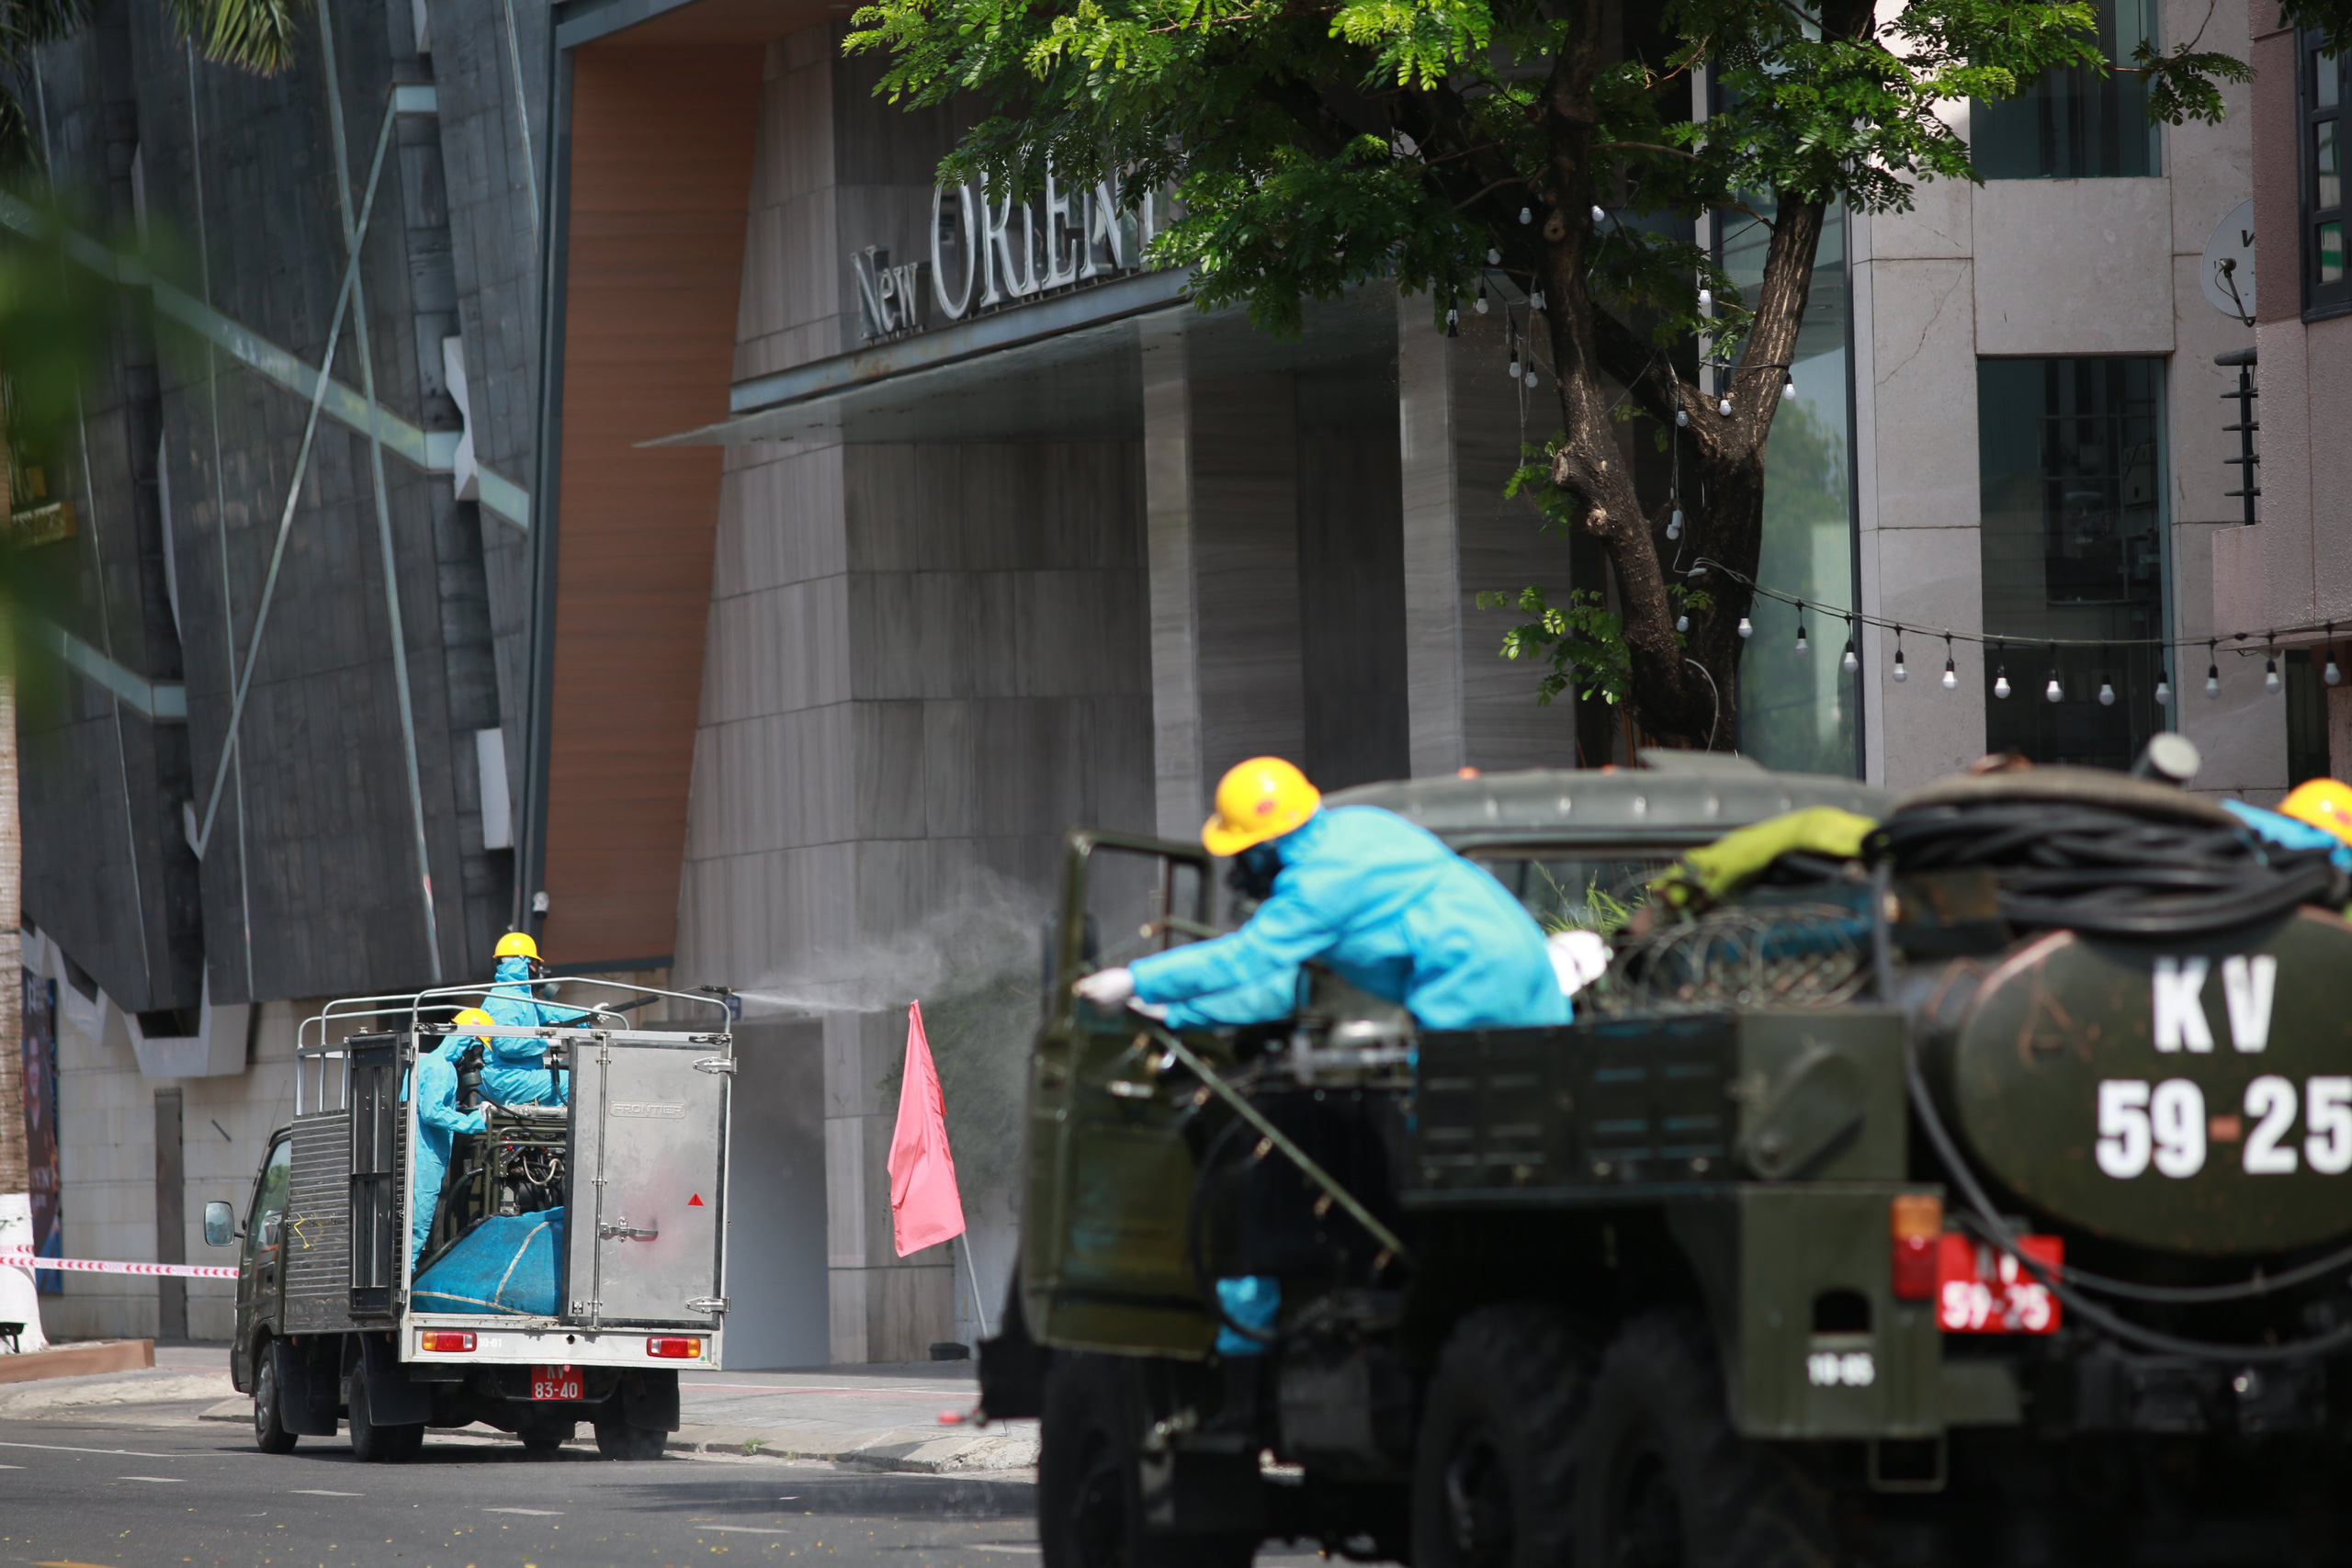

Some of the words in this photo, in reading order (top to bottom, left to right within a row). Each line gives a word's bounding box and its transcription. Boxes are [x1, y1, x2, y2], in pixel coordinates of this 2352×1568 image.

[850, 244, 918, 340] New
[614, 1103, 683, 1116] FRONTIER
[2096, 1074, 2352, 1179] 59-25
[480, 1337, 502, 1348] 10-01
[535, 1382, 578, 1398] 83-40
